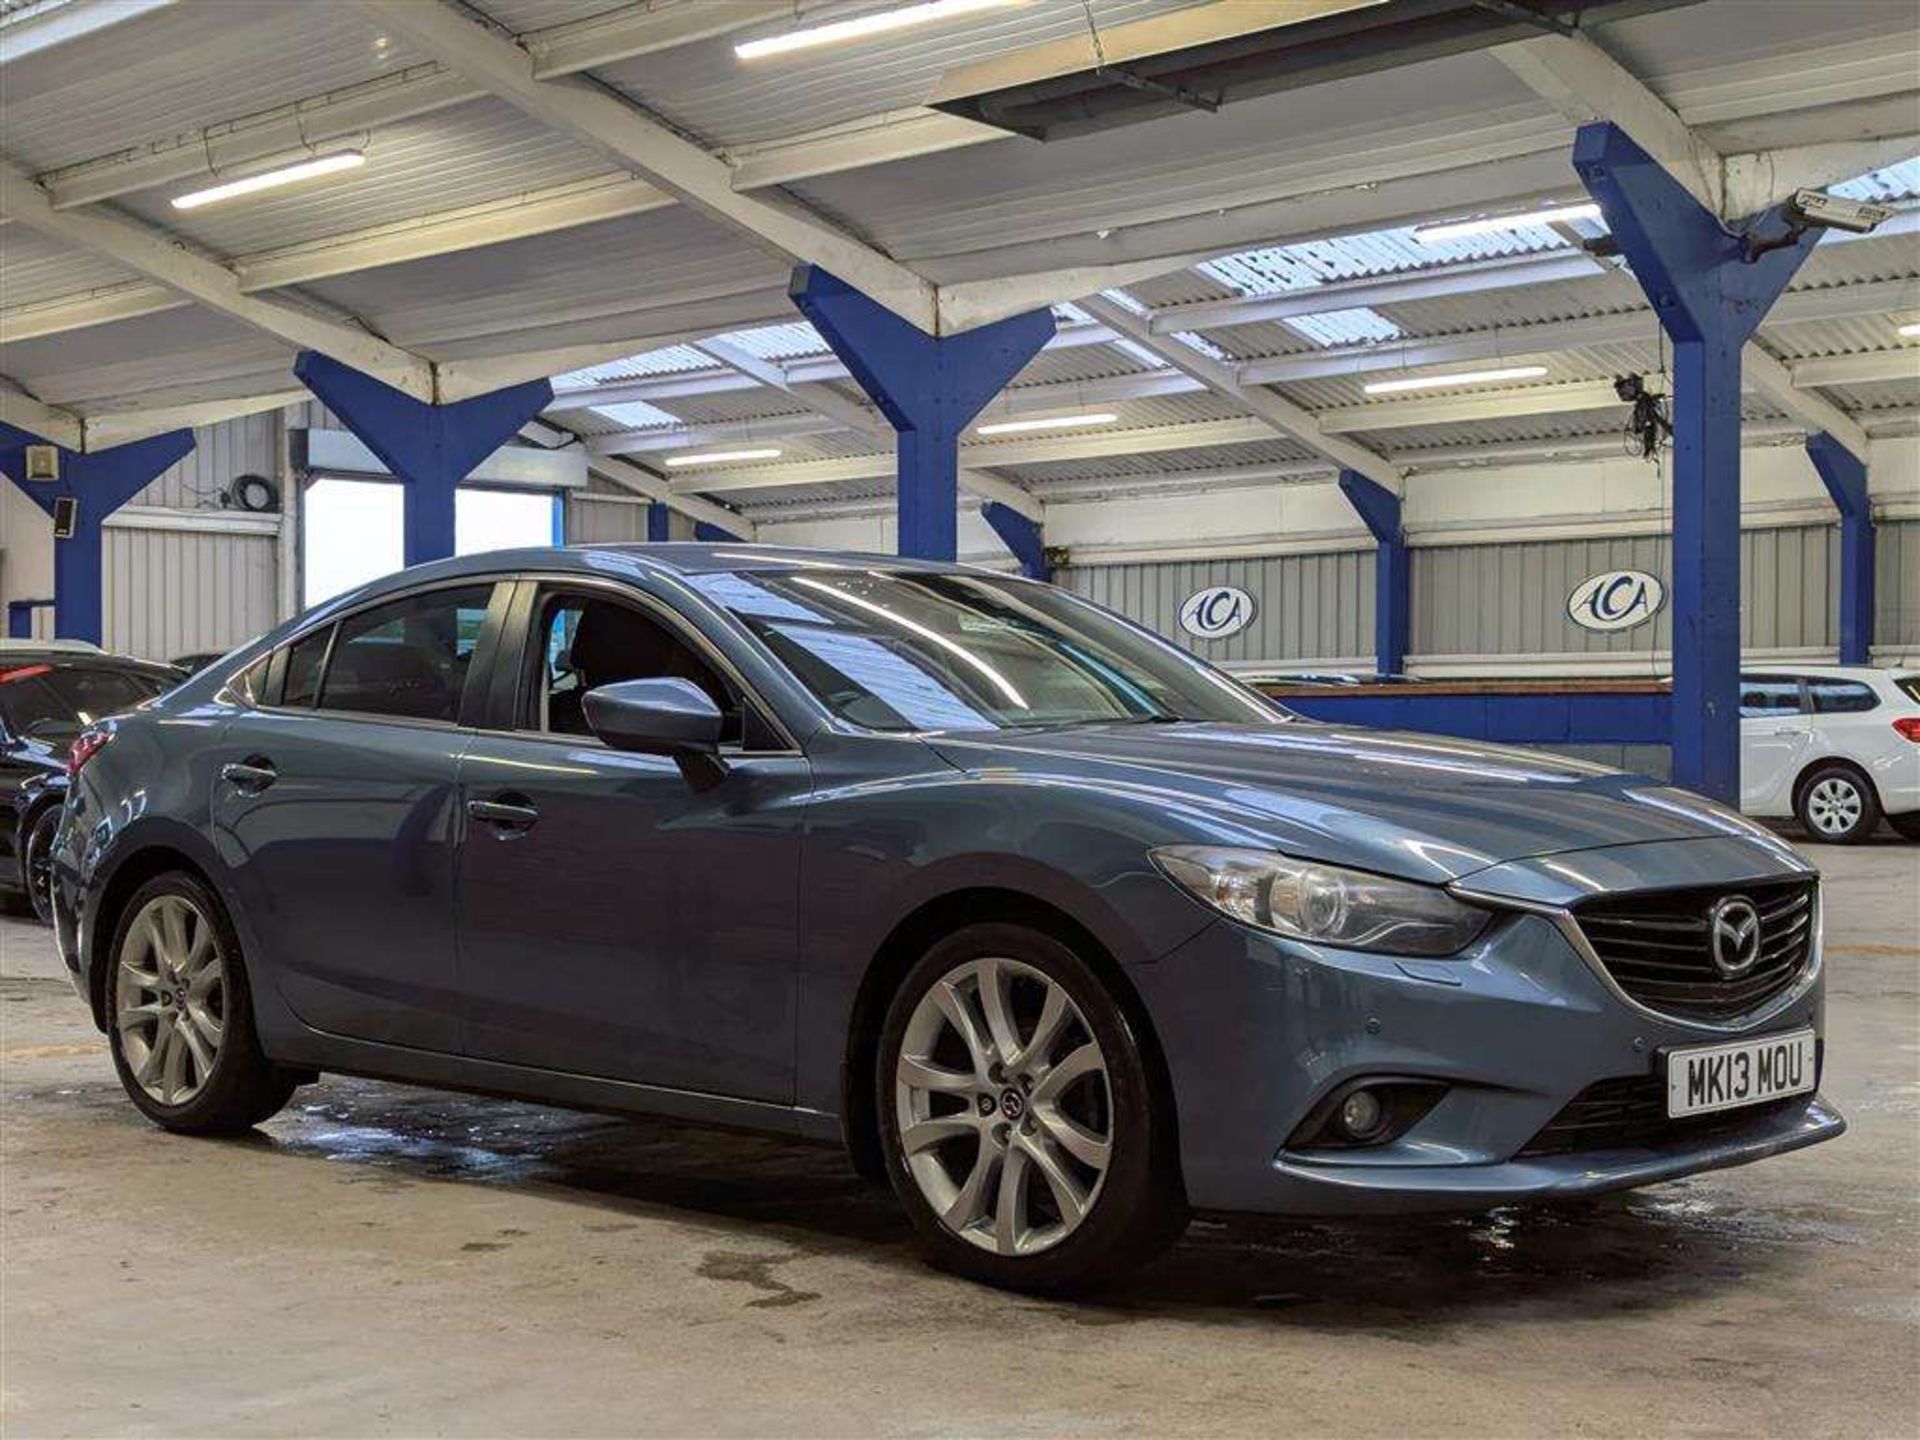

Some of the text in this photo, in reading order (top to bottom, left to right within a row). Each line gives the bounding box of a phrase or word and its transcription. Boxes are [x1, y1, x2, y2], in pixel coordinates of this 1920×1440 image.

[1183, 591, 1242, 631] ACA
[1573, 576, 1649, 621] ACA
[1687, 1041, 1803, 1107] MK13 MOU
